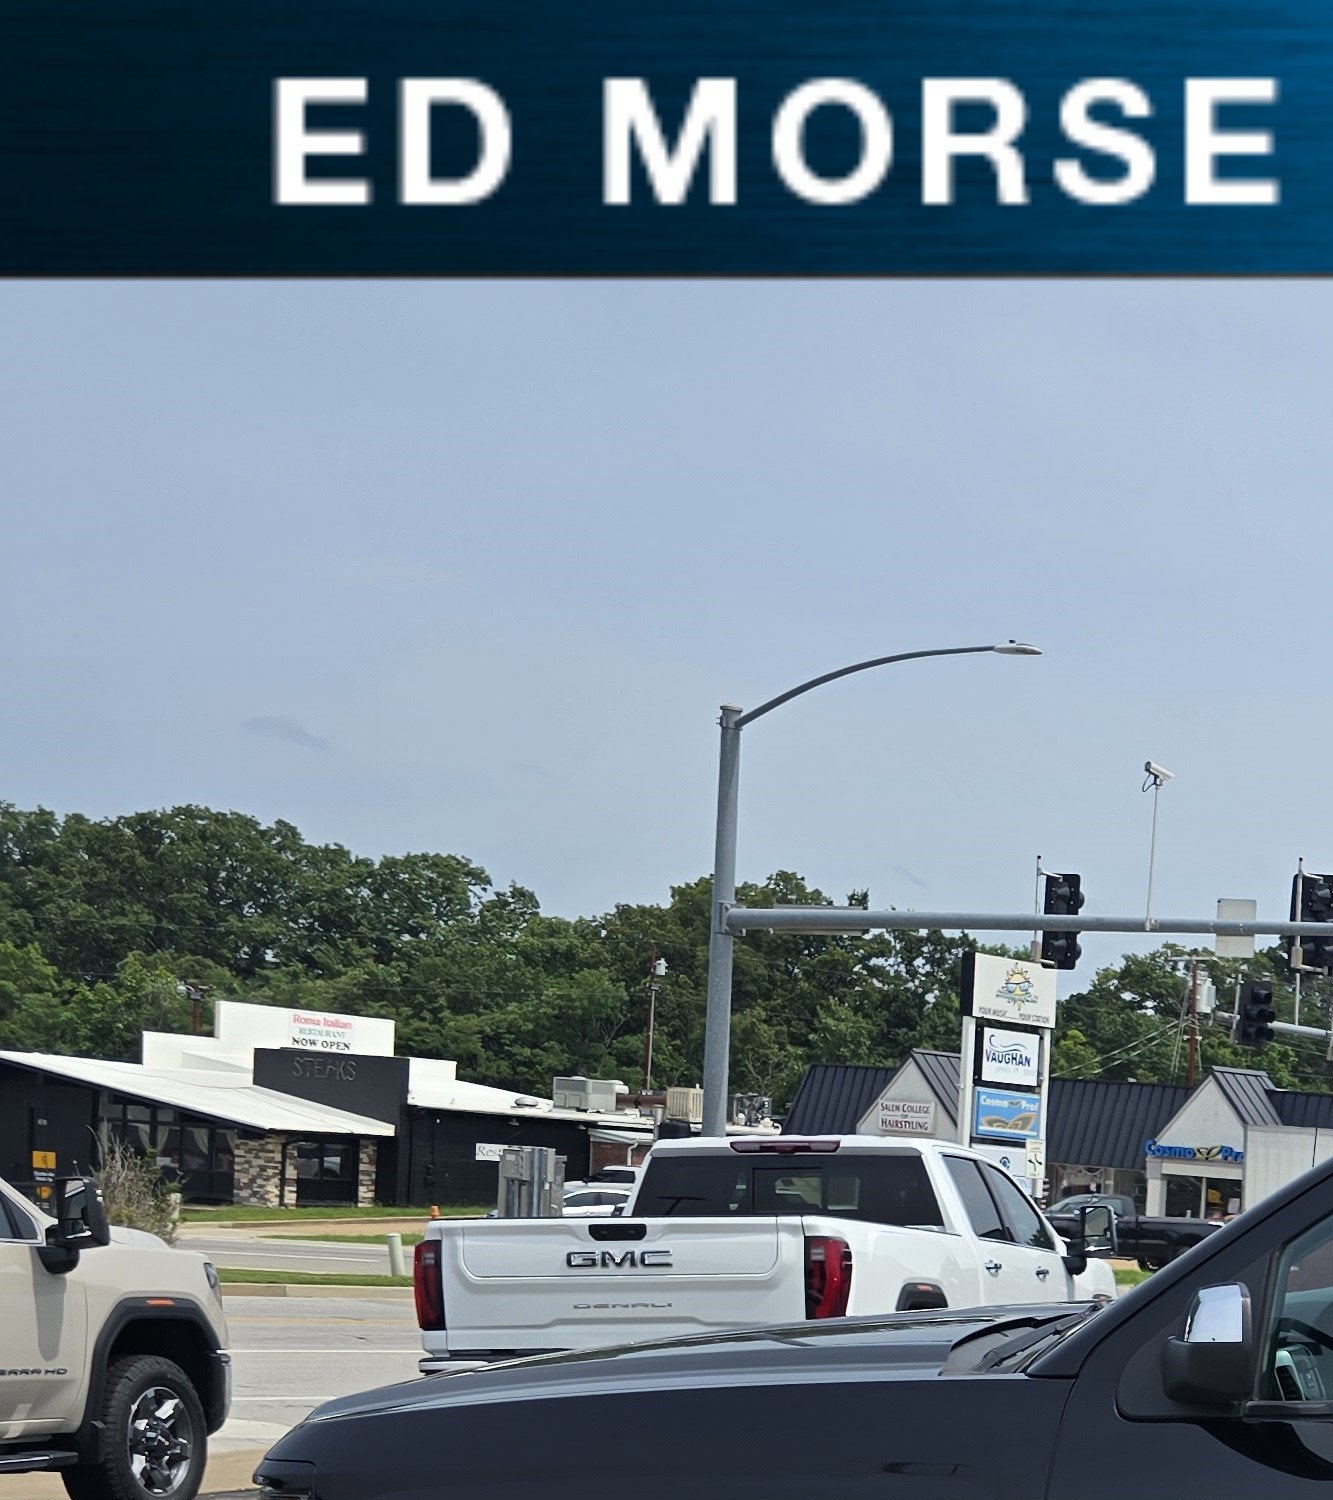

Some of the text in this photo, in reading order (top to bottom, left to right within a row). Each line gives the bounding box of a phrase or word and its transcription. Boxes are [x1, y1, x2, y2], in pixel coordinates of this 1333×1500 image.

[293, 1013, 353, 1030] Roma Italian
[291, 1036, 352, 1051] NOW OPEN
[985, 1049, 1032, 1067] VAUGHAN
[980, 1094, 1009, 1108] Cosmo
[901, 1103, 930, 1115] COLLEGE
[881, 1118, 929, 1131] HAIRSTYLING
[1143, 1139, 1197, 1159] Cosmo
[566, 1250, 674, 1268] GMC
[573, 1302, 673, 1310] DENALI
[44, 1367, 68, 1376] HD
